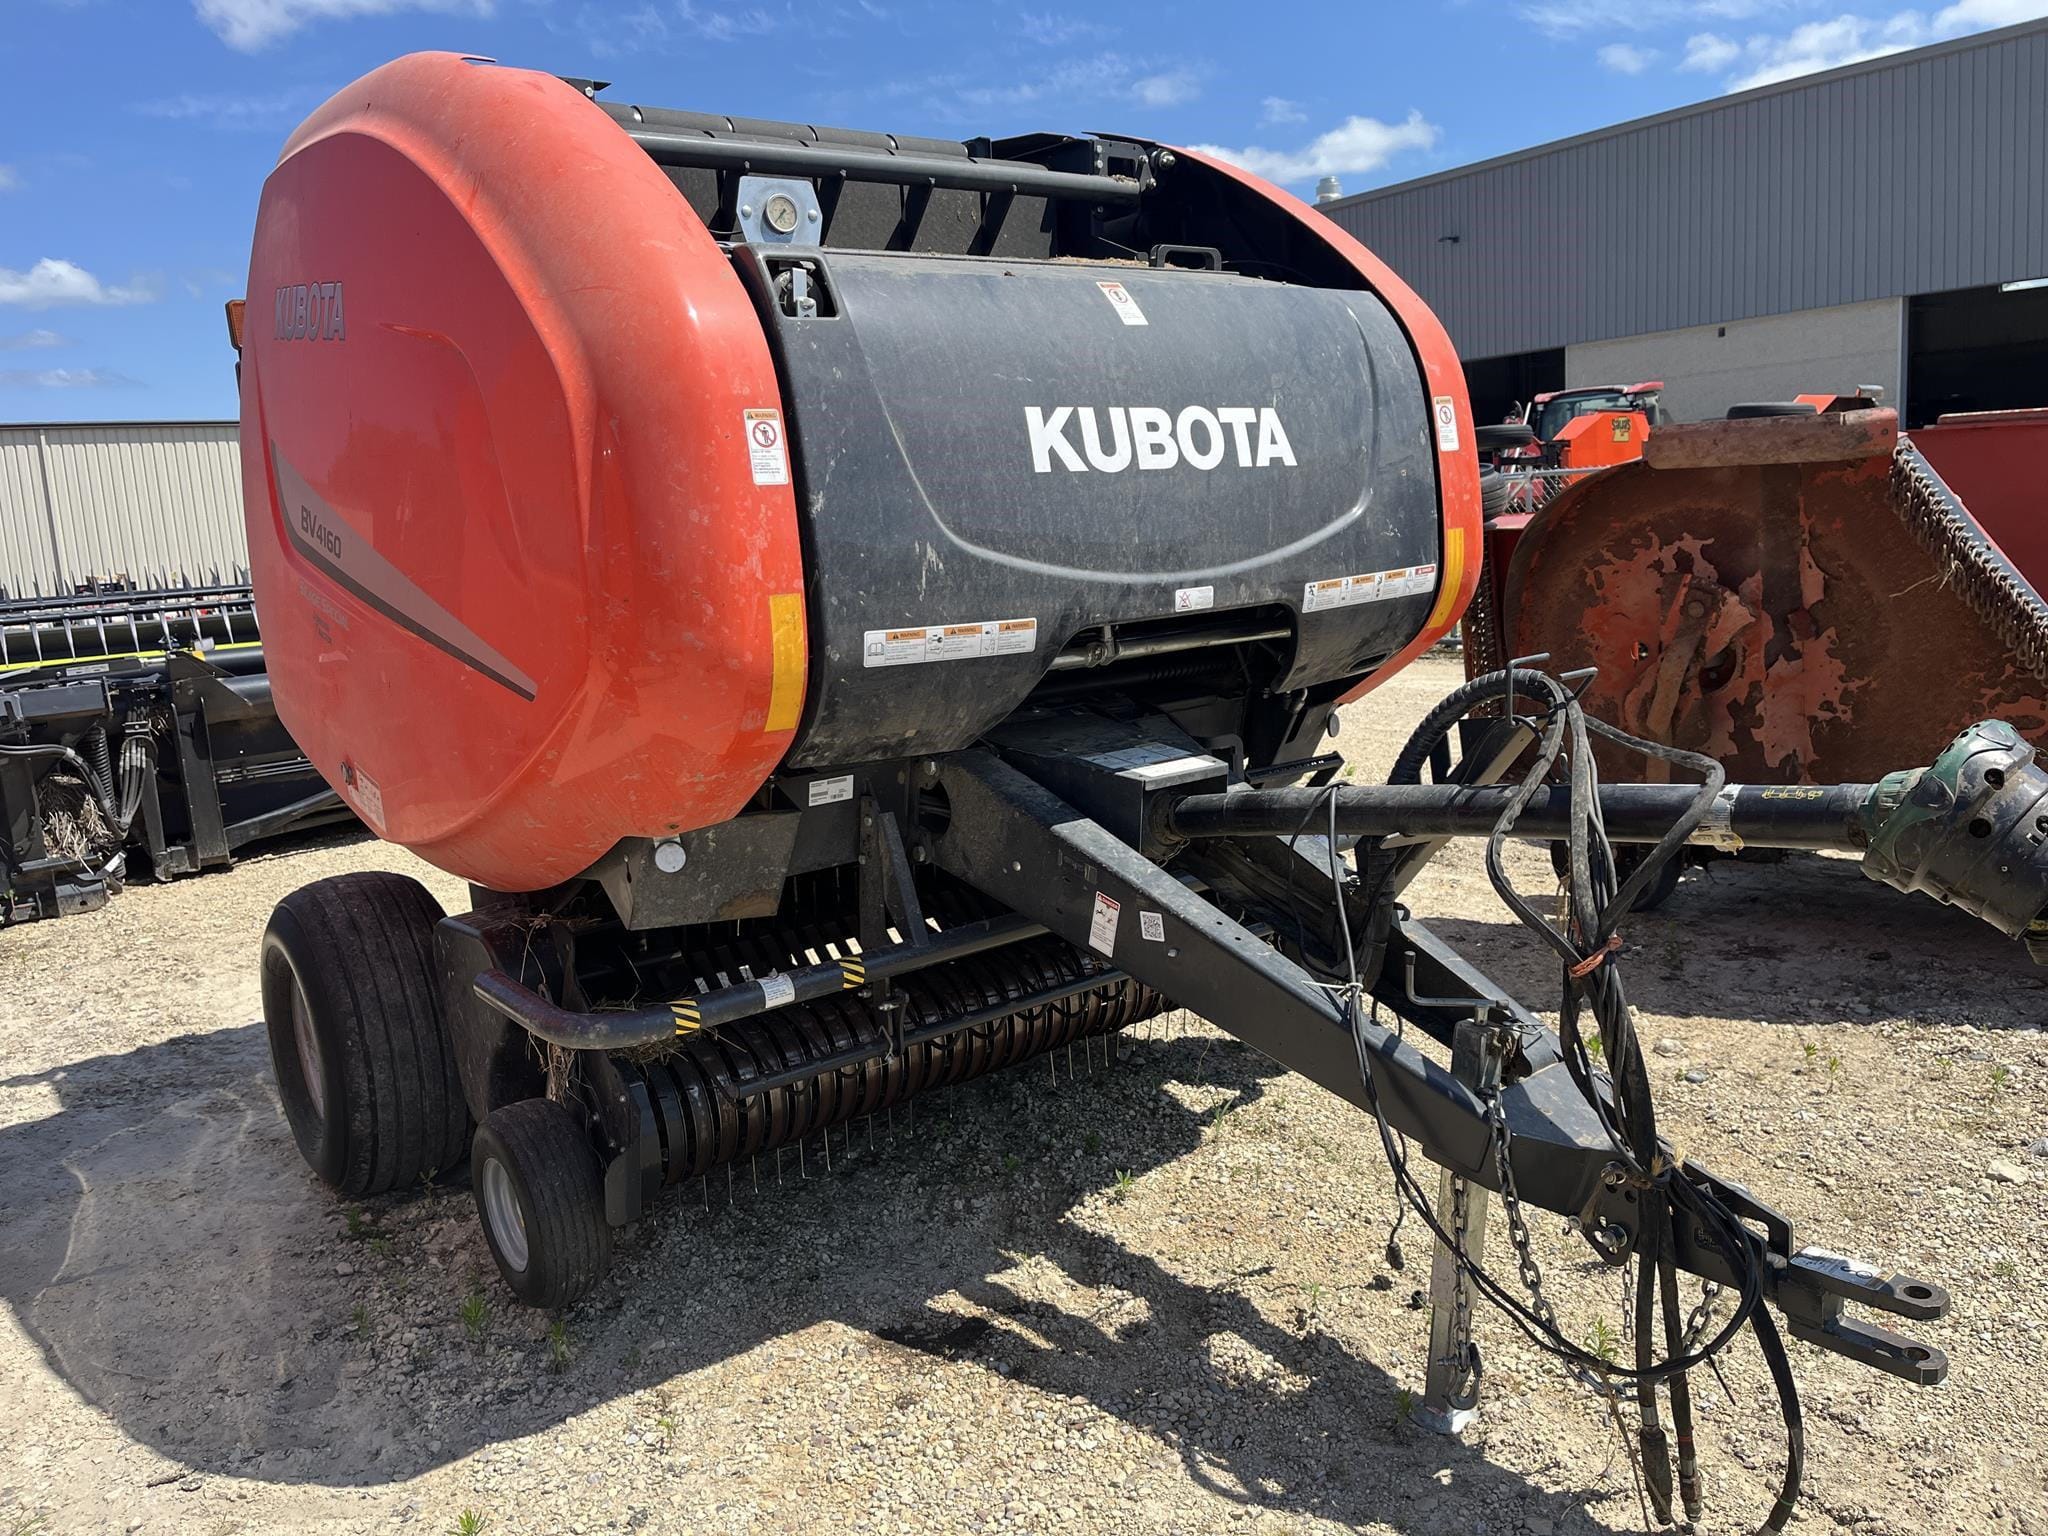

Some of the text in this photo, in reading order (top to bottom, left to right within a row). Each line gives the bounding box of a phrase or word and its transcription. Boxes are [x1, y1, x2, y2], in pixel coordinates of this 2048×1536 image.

[274, 281, 346, 341] KUBOTA
[1024, 405, 1298, 473] KUBOTA
[301, 504, 342, 559] BV4160
